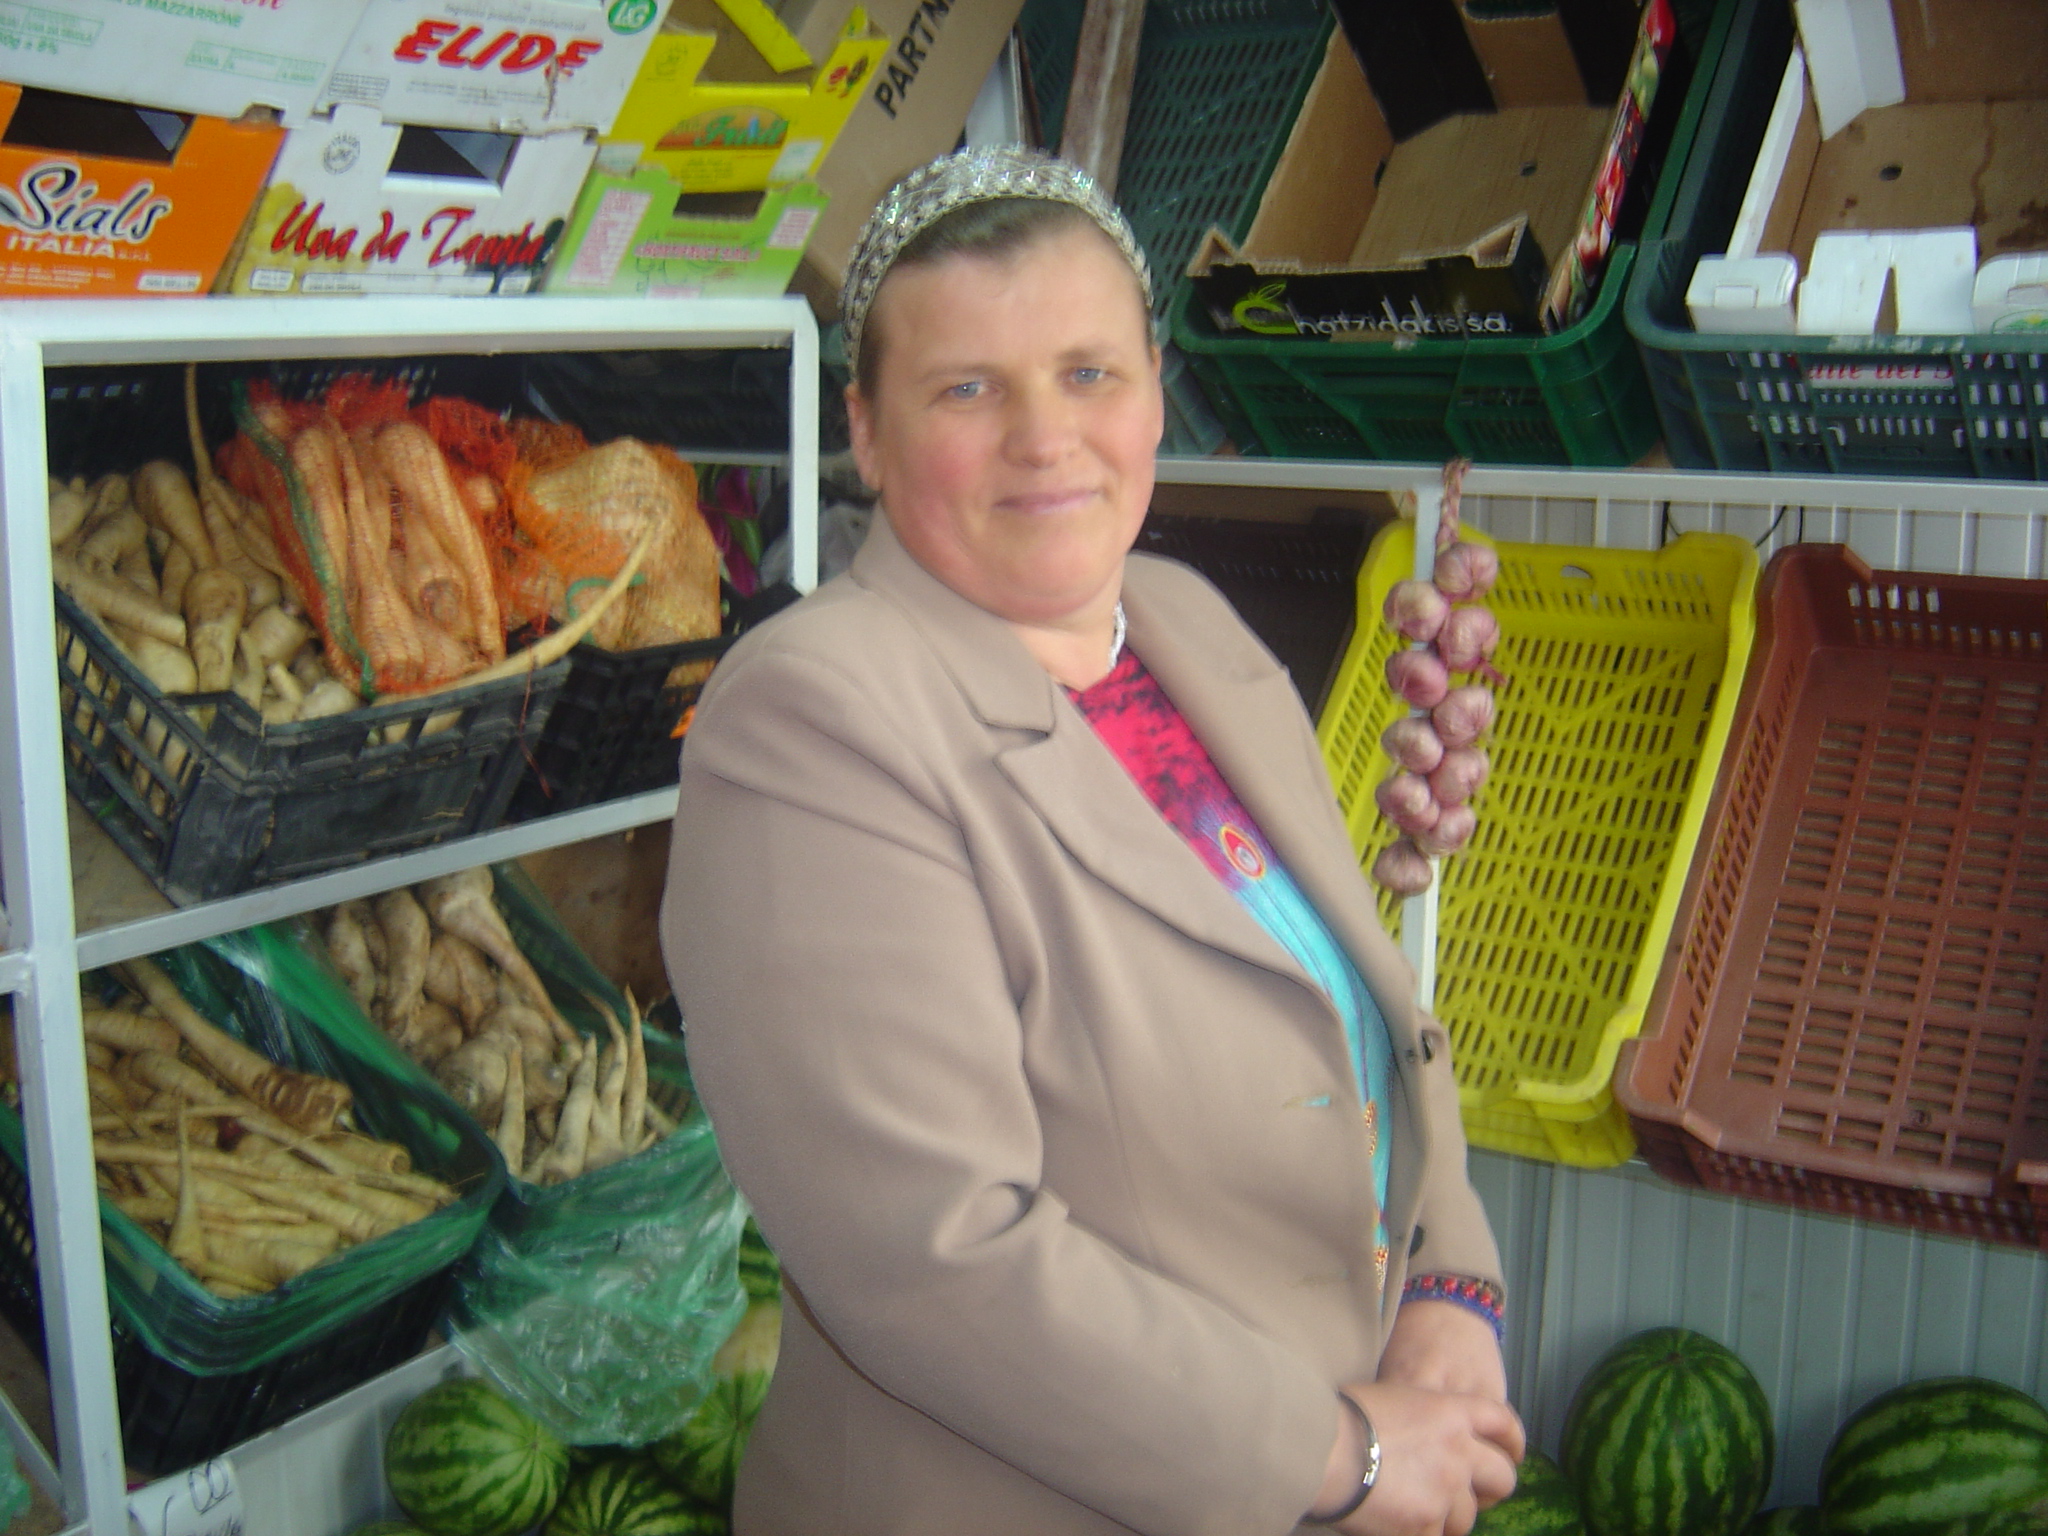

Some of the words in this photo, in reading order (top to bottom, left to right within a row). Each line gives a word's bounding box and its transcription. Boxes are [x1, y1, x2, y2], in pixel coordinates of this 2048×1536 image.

[394, 19, 602, 73] ELIDE
[874, 0, 957, 119] PARTN
[20, 161, 171, 243] Sials
[7, 233, 116, 260] ITALIA
[361, 210, 411, 264] da
